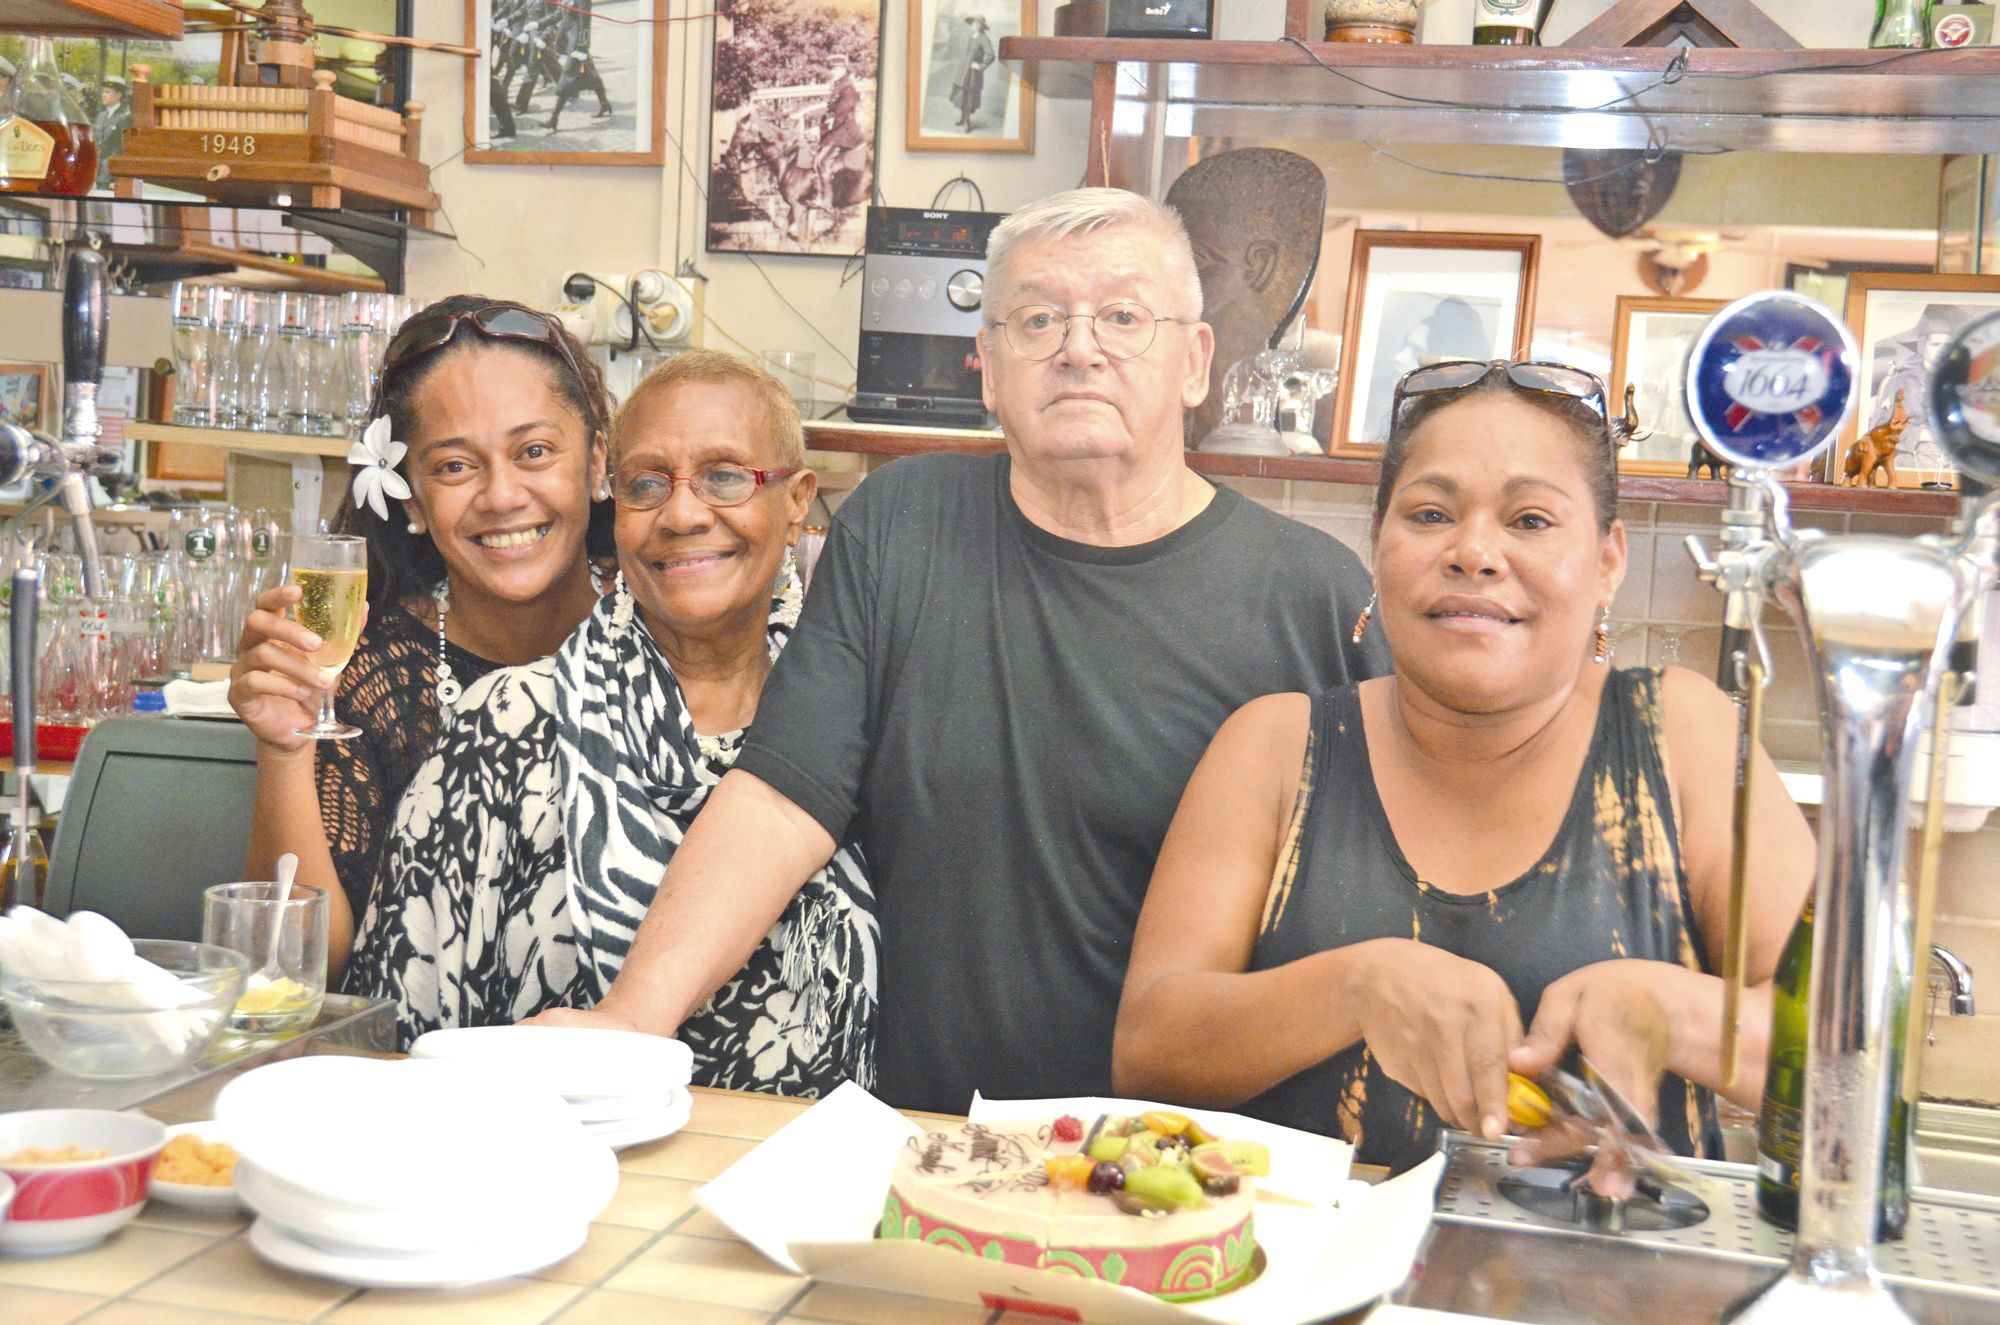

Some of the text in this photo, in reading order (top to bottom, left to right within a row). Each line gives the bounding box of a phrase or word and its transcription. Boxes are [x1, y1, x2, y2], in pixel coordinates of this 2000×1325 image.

[200, 134, 256, 156] 1948
[1739, 362, 1810, 400] 1664
[193, 536, 207, 551] 1
[258, 534, 266, 547] 1
